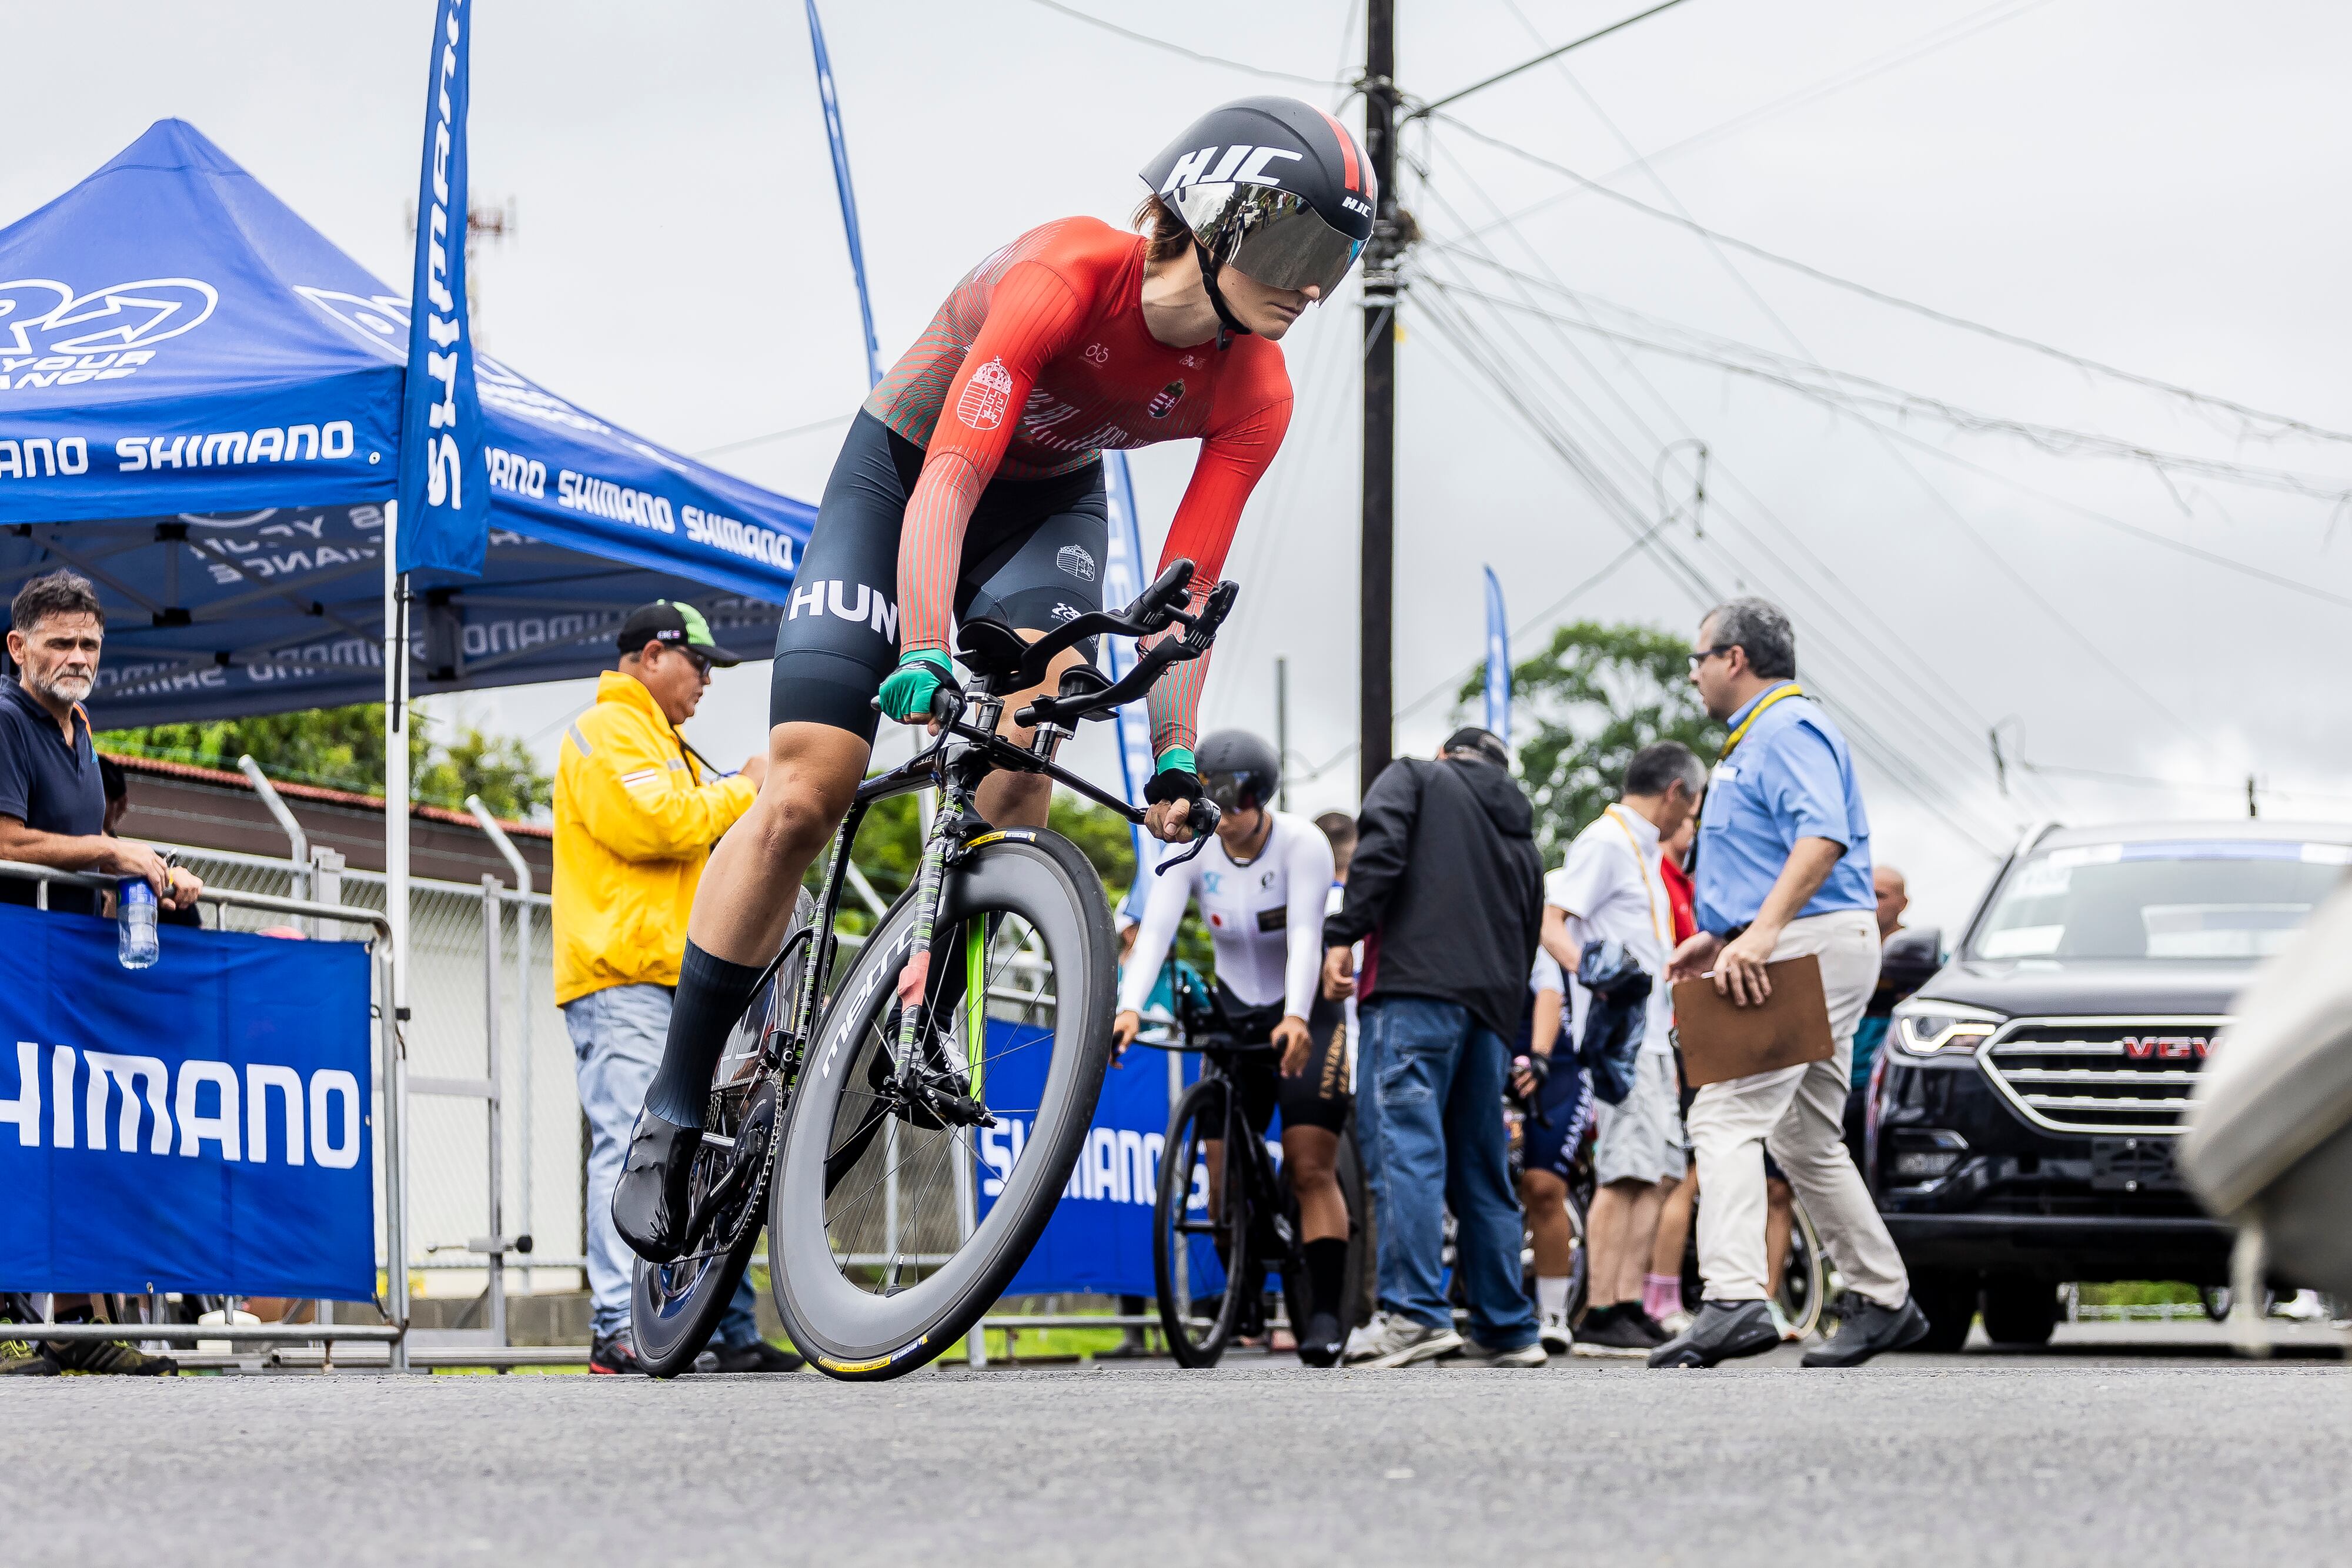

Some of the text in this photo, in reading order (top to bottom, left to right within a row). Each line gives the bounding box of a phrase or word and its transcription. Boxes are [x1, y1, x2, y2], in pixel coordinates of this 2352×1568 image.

[1159, 145, 1303, 195] HJC
[1342, 196, 1373, 218] HJC
[2, 350, 156, 373] YOUR
[115, 419, 355, 472] SHIMANO
[485, 446, 546, 499] ANO
[557, 469, 676, 534] SHIMANO
[680, 504, 794, 571] SHIMANO
[789, 580, 898, 644] HUN
